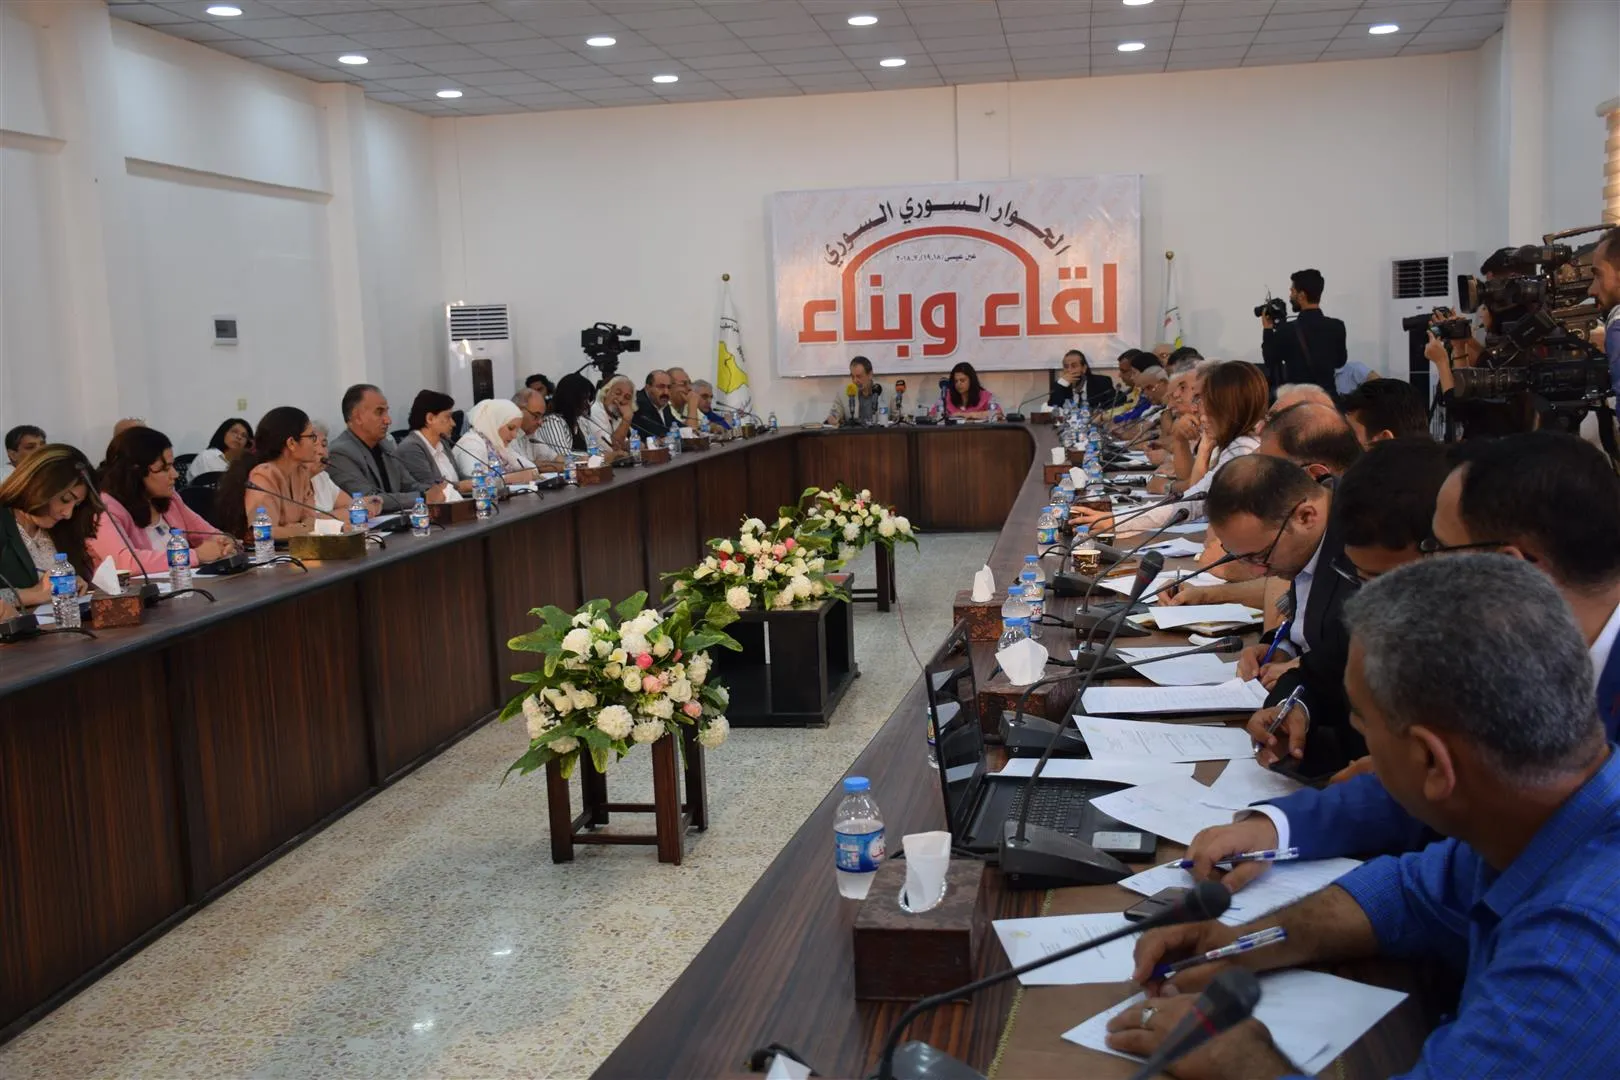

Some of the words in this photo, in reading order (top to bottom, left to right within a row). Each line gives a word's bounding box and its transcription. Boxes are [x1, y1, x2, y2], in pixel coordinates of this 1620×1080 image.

[823, 200, 894, 267] السوري
[899, 192, 990, 224] السوري
[990, 200, 1071, 257] الحوار
[798, 273, 958, 358] وبناء
[979, 263, 1118, 338] لقاء
